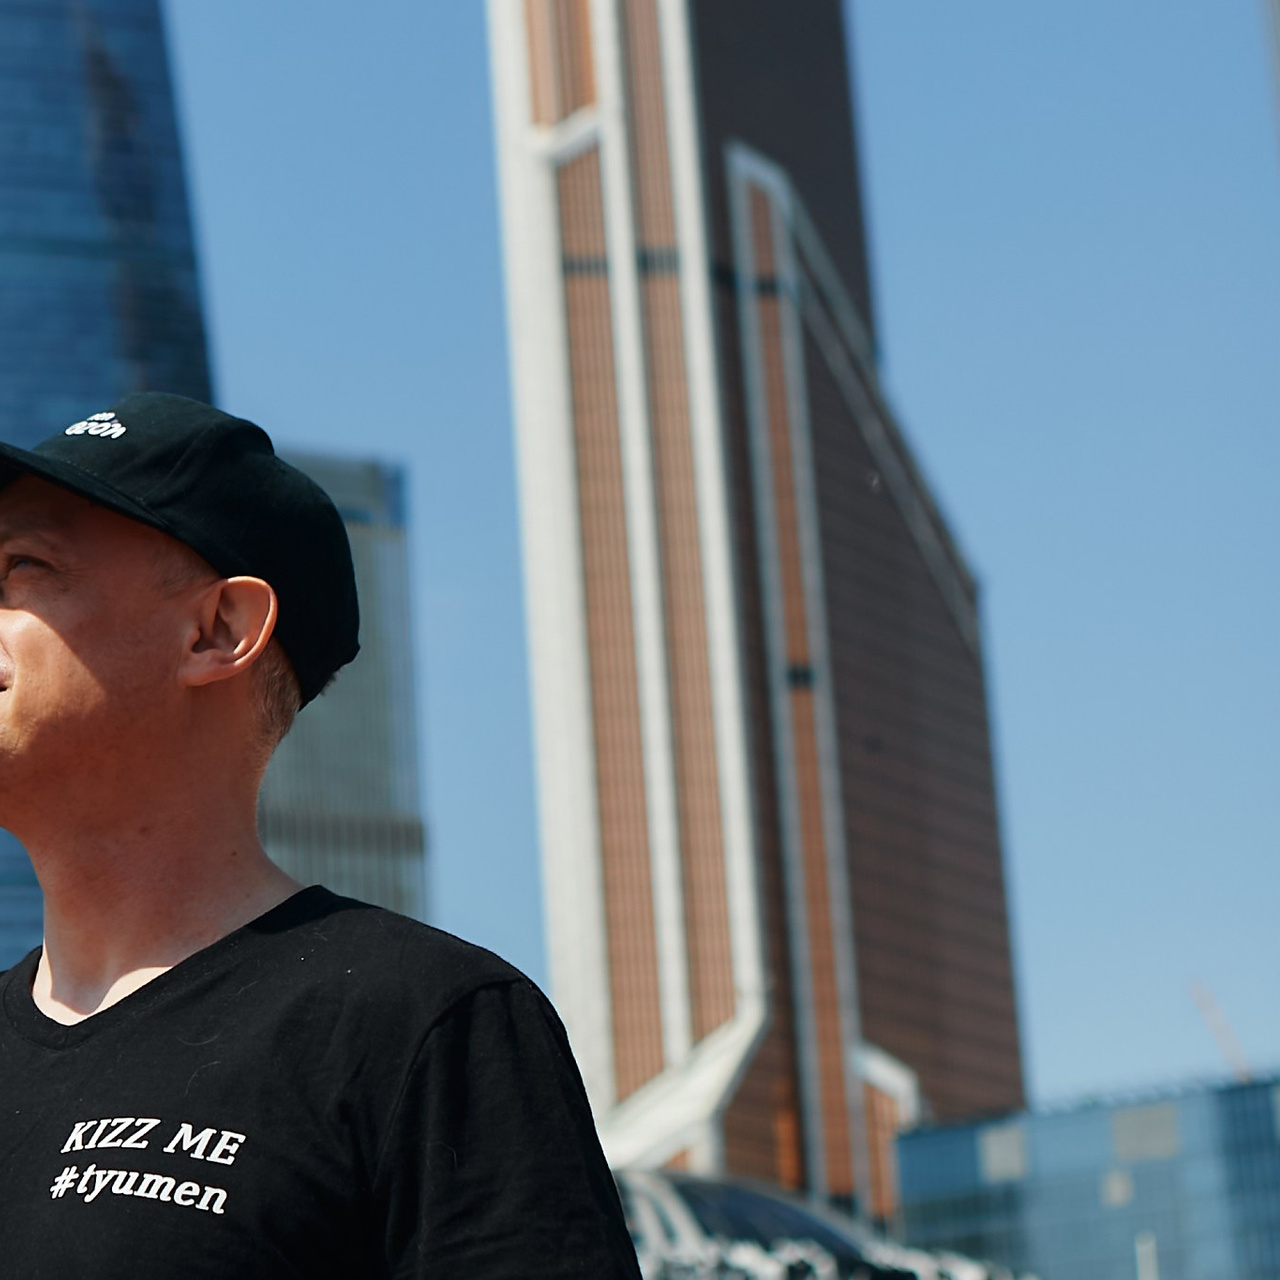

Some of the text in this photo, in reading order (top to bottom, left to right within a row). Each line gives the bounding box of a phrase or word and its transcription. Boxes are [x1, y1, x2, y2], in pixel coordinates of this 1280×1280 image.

[60, 1117, 246, 1166] KIZZ ME
[50, 1163, 228, 1214] #tyumen
